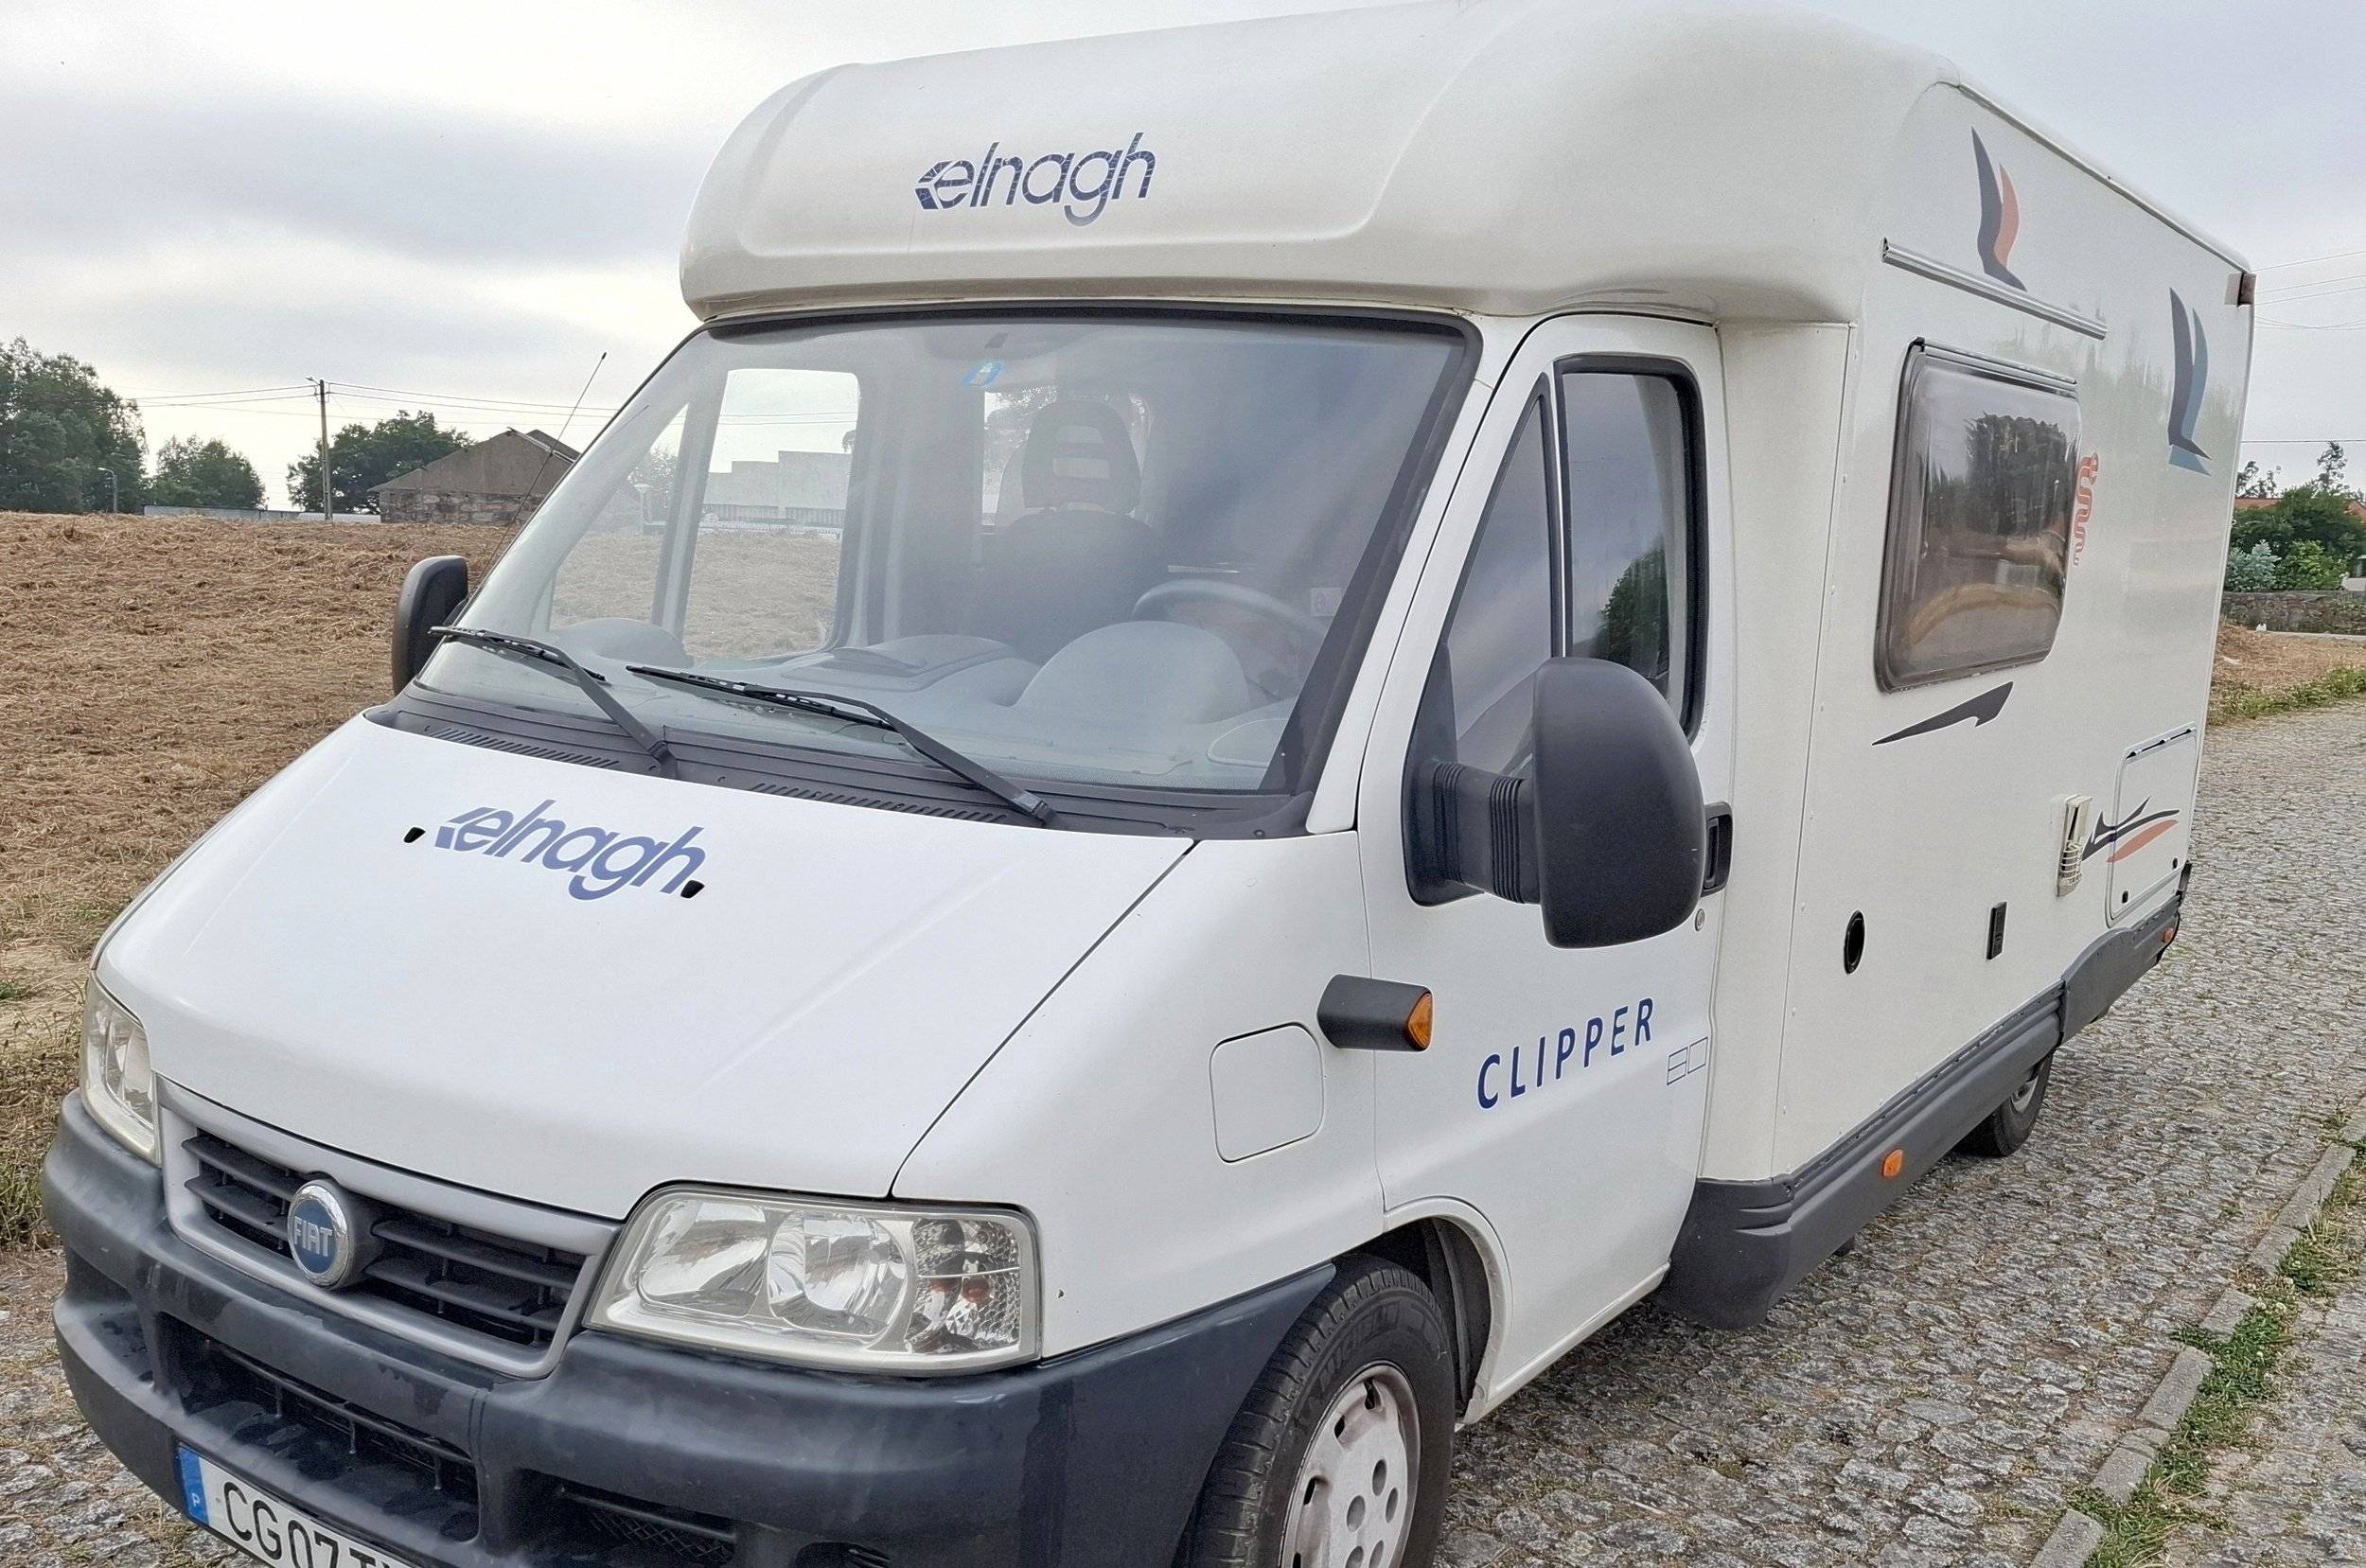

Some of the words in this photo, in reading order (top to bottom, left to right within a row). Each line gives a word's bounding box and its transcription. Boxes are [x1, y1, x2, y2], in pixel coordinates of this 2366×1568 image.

[915, 132, 1157, 226] elnagh
[435, 799, 706, 900] elnagh
[1477, 997, 1653, 1109] CLIPPER
[293, 1215, 333, 1258] FIAT
[191, 1492, 201, 1507] P
[223, 1481, 390, 1568] CG07
